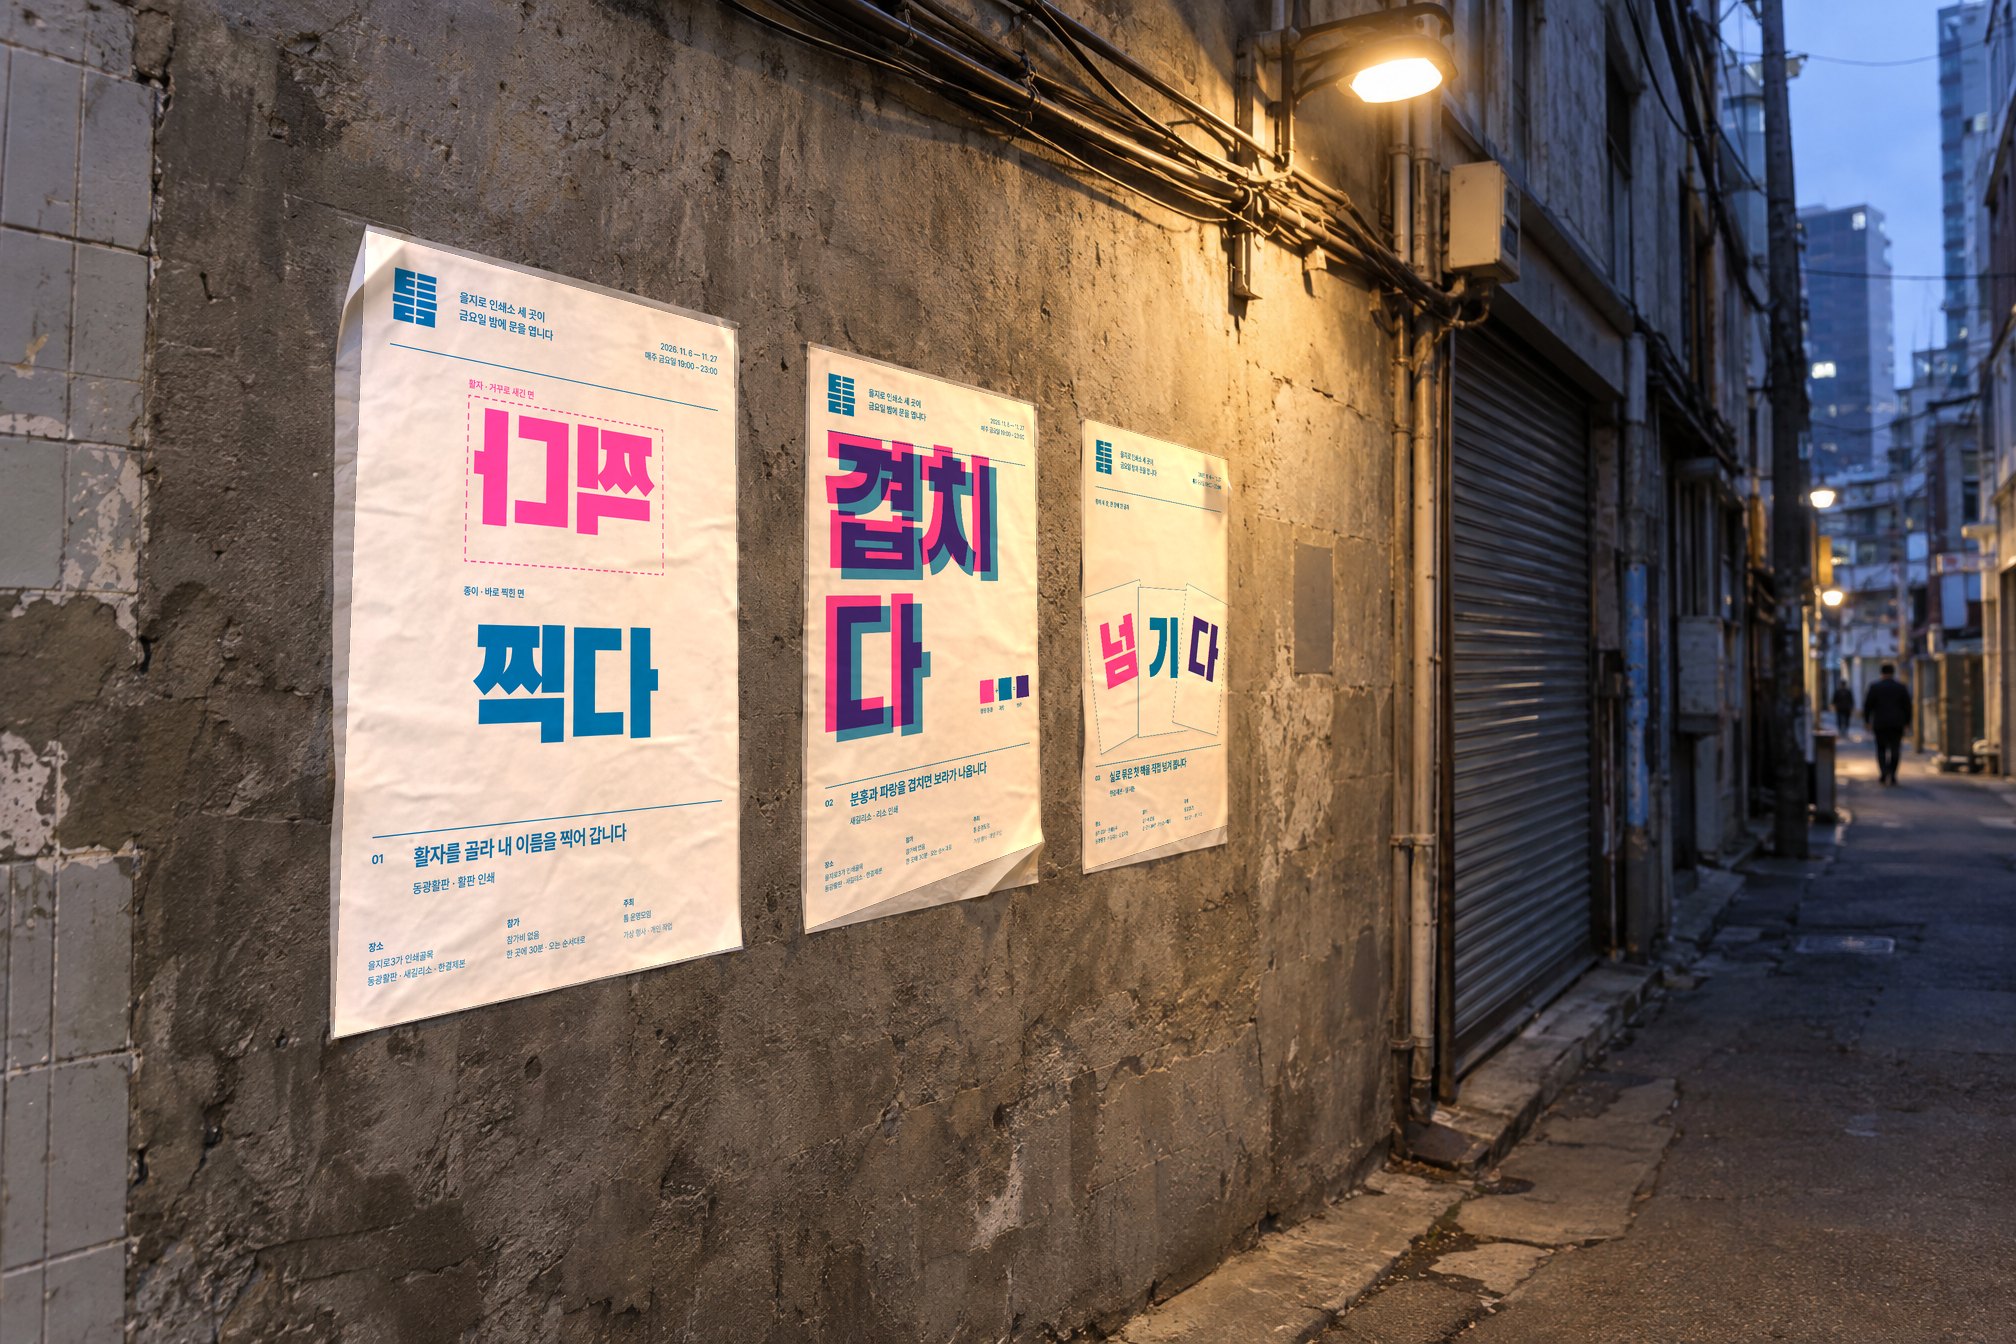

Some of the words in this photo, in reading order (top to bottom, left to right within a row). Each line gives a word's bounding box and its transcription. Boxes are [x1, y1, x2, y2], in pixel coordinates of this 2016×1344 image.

[460, 292, 487, 308] 을지로
[489, 300, 515, 315] 인쇄소
[518, 307, 526, 318] 세
[529, 309, 545, 323] 곳이
[459, 309, 487, 326] 금요일
[489, 316, 507, 331] 밤에
[509, 321, 526, 335] 문을
[528, 325, 553, 341] 엽니다
[660, 343, 678, 354] 2026.
[710, 355, 717, 363] 27
[659, 354, 676, 366] 금요일
[677, 359, 694, 370] 19:00
[700, 365, 717, 375] 23:00
[469, 379, 483, 390] 활자
[489, 384, 510, 394] 거꾸로
[512, 387, 525, 398] 새긴
[528, 390, 534, 400] 면
[826, 431, 998, 581] 겹치
[464, 585, 478, 596] 종이
[484, 587, 499, 597] 바로
[501, 588, 515, 598] 찍힌
[518, 589, 524, 598] 면
[826, 593, 930, 742] 다
[473, 624, 658, 743] 찍다
[825, 799, 833, 807] 02
[850, 787, 878, 807] 분홍과
[879, 780, 906, 798] 파랑을
[908, 774, 932, 793] 겹치면
[934, 768, 957, 786] 보라가
[958, 761, 987, 779] 나옵니다
[1110, 769, 1121, 783] 실로
[1134, 766, 1139, 778] 첫
[850, 813, 872, 825] 새길리소
[876, 809, 887, 818] 리소
[888, 805, 898, 816] 인쇄
[371, 854, 384, 865] 01
[413, 843, 461, 868] 활자를
[464, 838, 494, 860] 골라
[498, 836, 512, 856] 내
[516, 831, 557, 853] 이름을
[560, 828, 586, 848] 찍어
[589, 823, 627, 845] 갑니다
[413, 877, 450, 894] 동광활판
[457, 874, 475, 888] 활판
[477, 872, 495, 886] 인쇄
[507, 918, 520, 928] 참가
[368, 942, 384, 953] 장소
[507, 933, 525, 944] 참가비
[527, 931, 539, 940] 없음
[368, 956, 403, 971] 을지로3가
[405, 949, 433, 964] 인쇄골목
[507, 949, 513, 959] 한
[515, 947, 527, 957] 곳에
[529, 944, 543, 954] 30분
[549, 941, 560, 950] 오는
[404, 966, 432, 978] 새길리소
